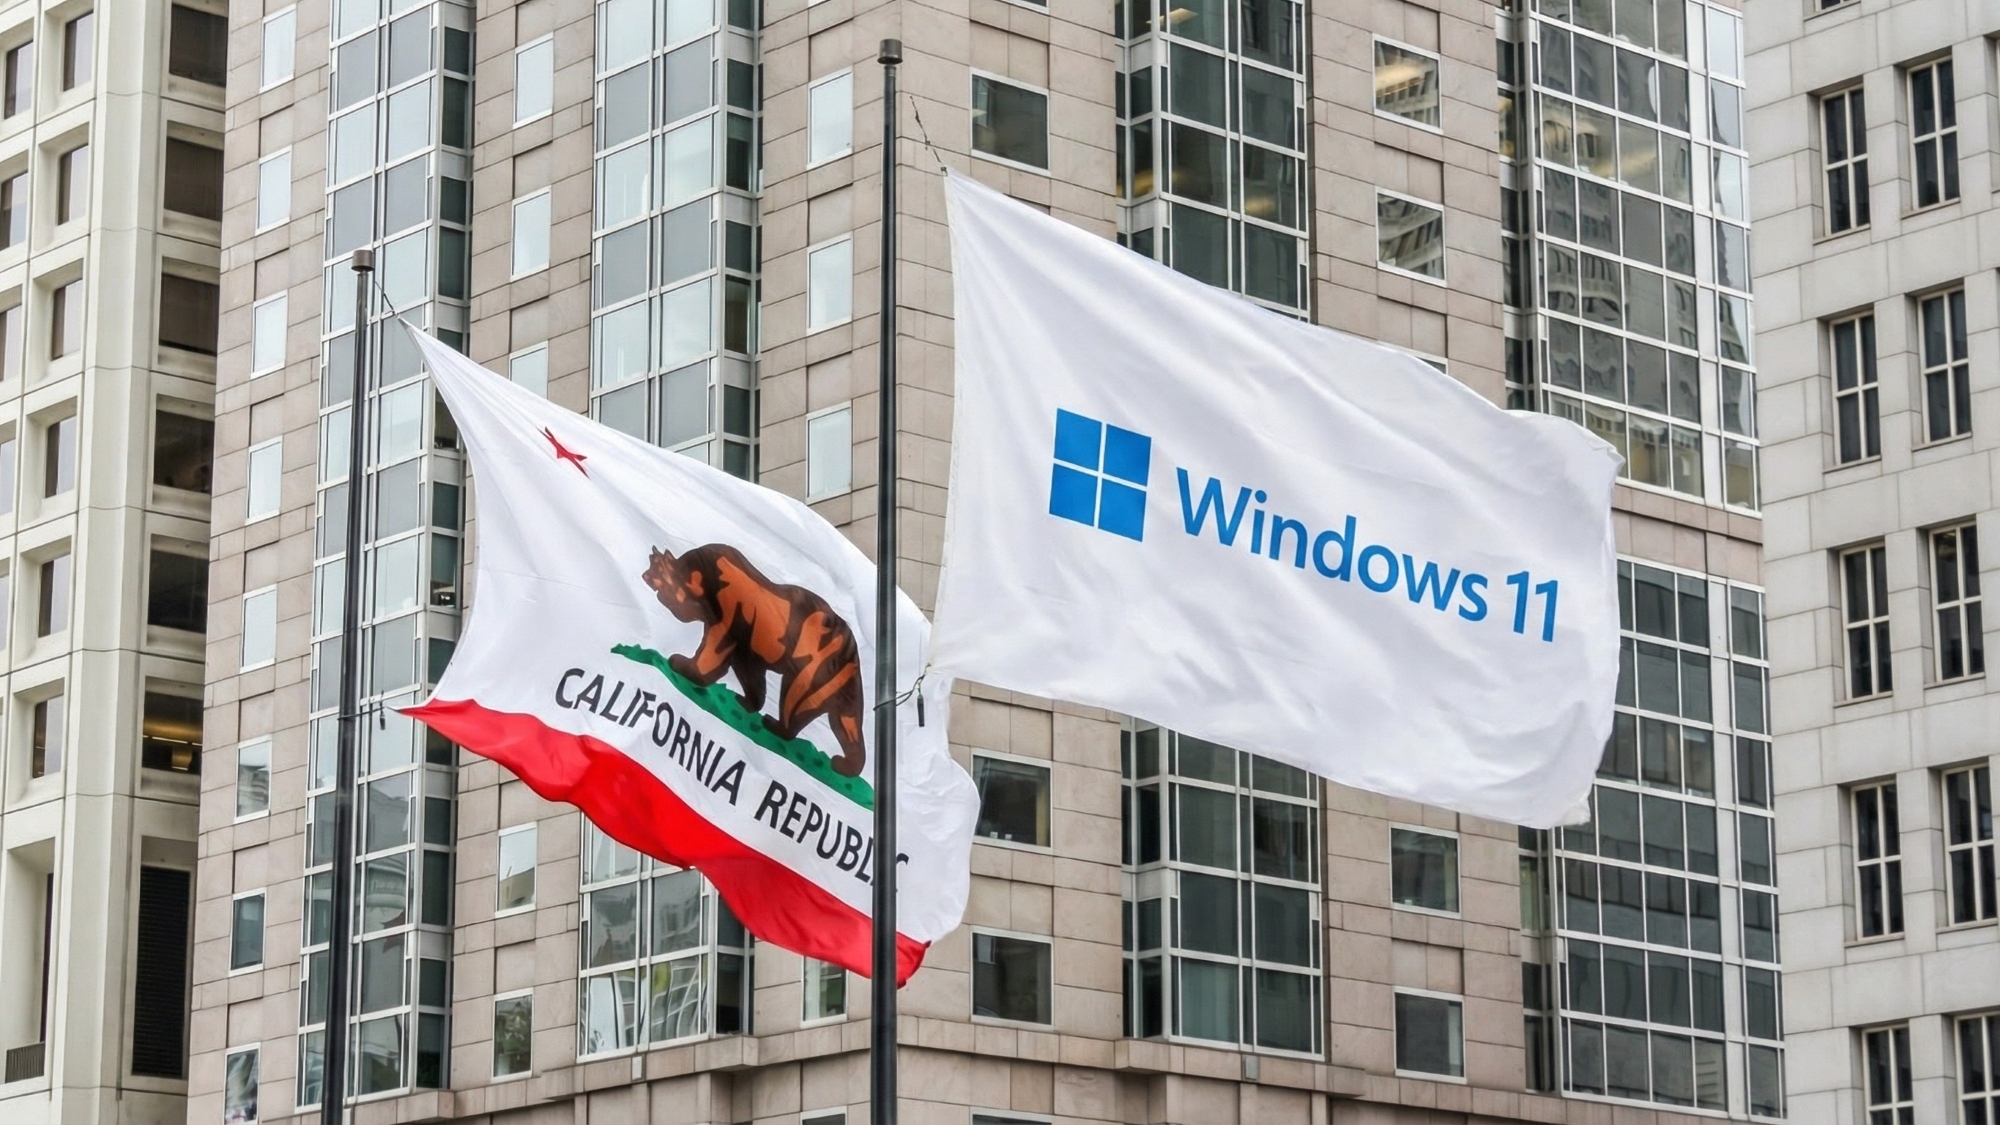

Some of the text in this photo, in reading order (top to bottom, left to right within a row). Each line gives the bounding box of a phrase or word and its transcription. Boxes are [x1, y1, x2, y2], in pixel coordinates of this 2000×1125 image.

[1176, 467, 1559, 642] Windows 11
[555, 668, 910, 894] CALIFORNIA REPUBL
